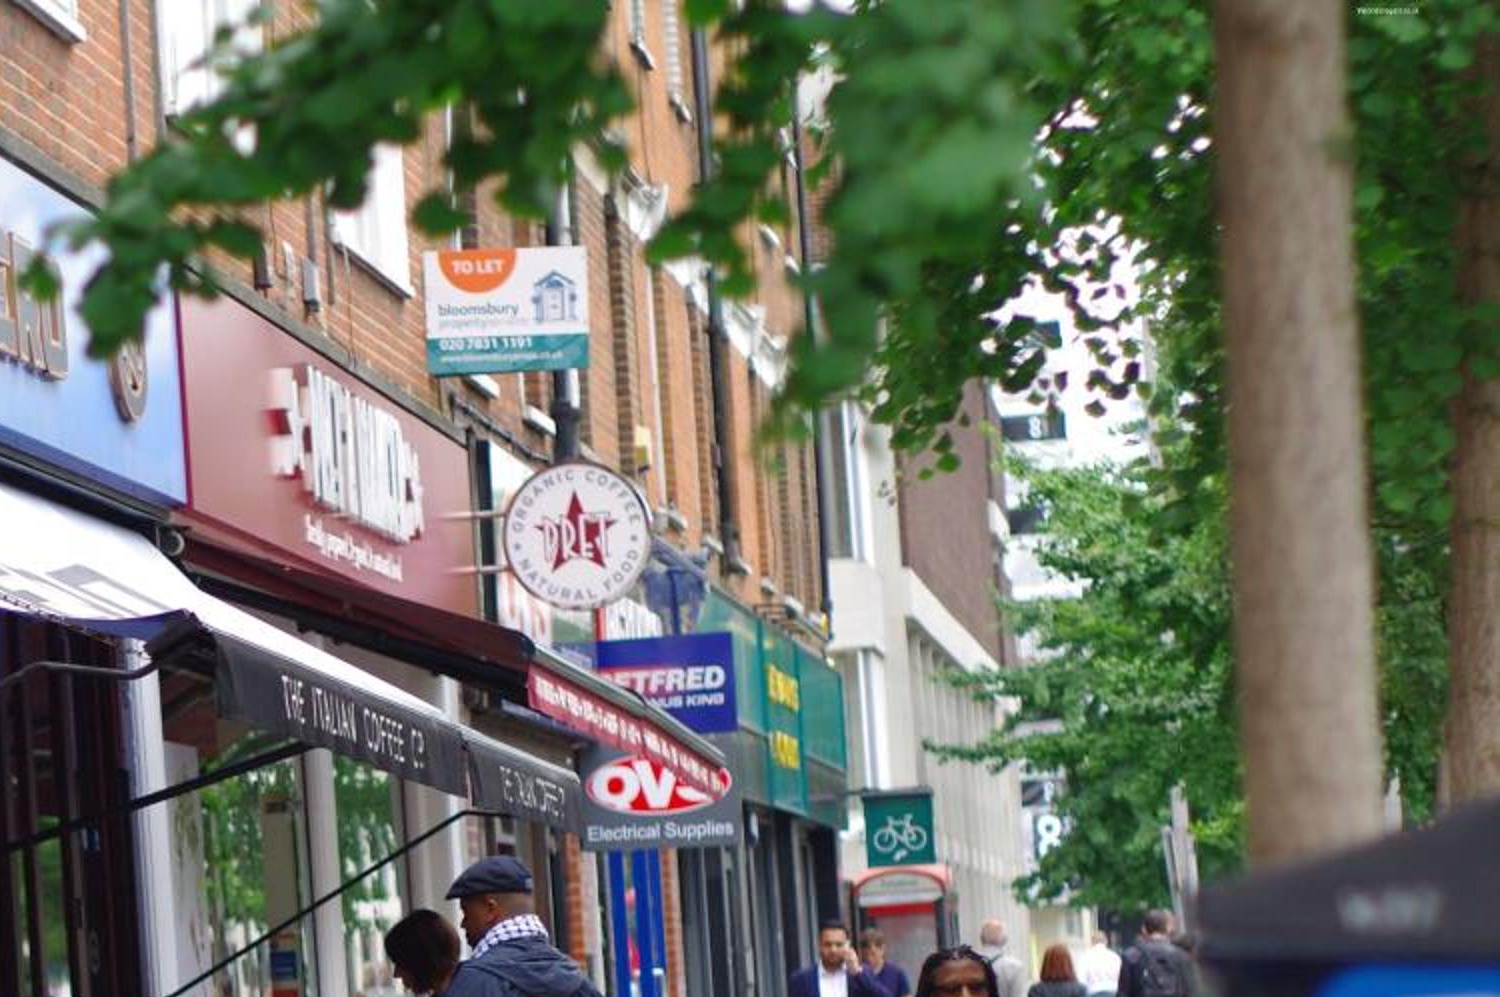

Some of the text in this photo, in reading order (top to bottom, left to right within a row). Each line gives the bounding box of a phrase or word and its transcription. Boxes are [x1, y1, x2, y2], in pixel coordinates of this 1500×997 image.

[452, 258, 505, 275] TO LET
[437, 302, 519, 318] bloomsbury
[439, 337, 467, 351] 020
[512, 469, 641, 533] ORGANIC COFFEE
[543, 511, 611, 563] PRET
[518, 548, 640, 601] NATURAL FOOD
[686, 693, 725, 708] KING
[280, 674, 306, 725] THE
[311, 687, 357, 743] ITALIAN
[362, 708, 406, 763] COFFEE
[587, 820, 735, 843] Electrical Supplies
